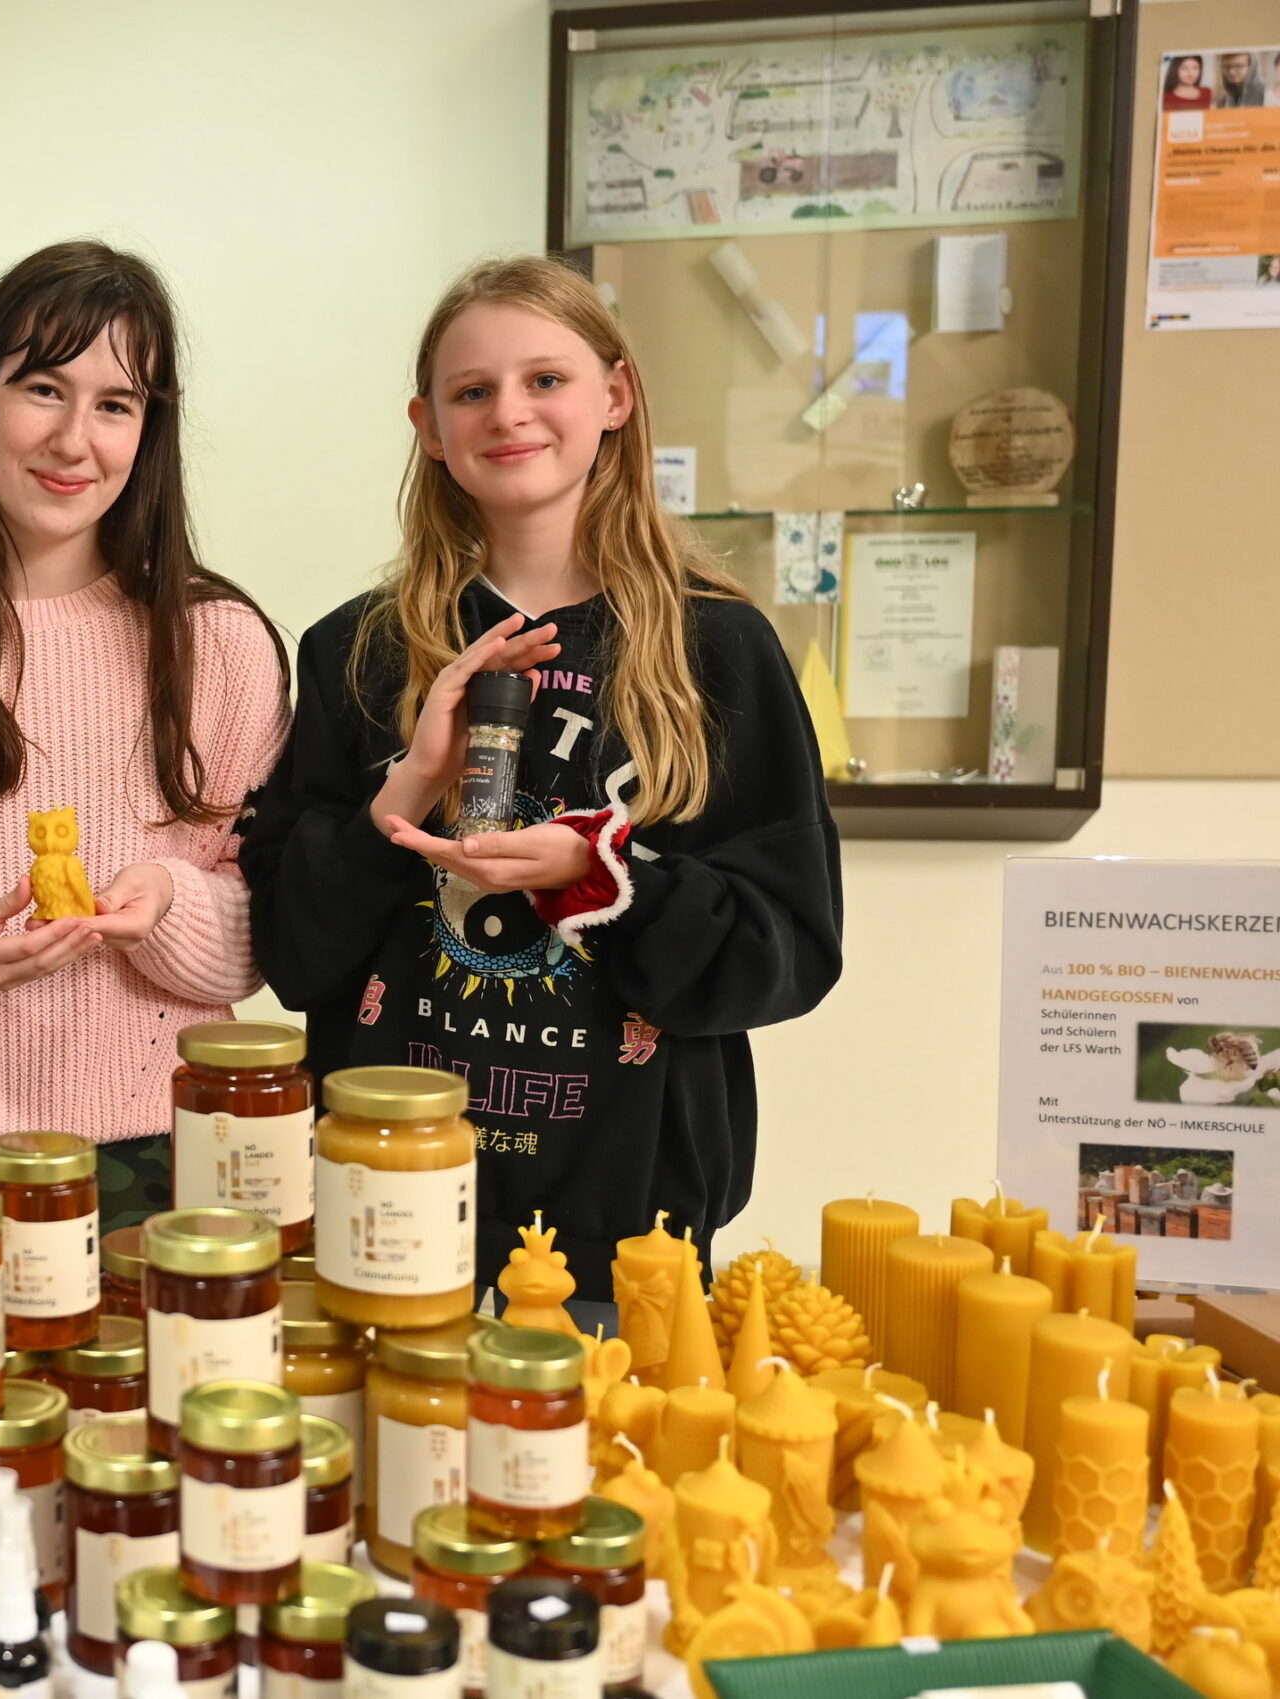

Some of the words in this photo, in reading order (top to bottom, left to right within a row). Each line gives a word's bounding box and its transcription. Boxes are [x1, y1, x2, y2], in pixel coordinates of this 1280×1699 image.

[1044, 910, 1280, 933] BIENENWACHSKERZE
[1042, 964, 1064, 976] Aus
[1067, 963, 1095, 976] 100
[1099, 964, 1113, 976] %
[1118, 964, 1146, 977] BIO
[1041, 988, 1174, 1004] HANDGEGOSSEN
[1177, 995, 1199, 1005] von
[1040, 1008, 1117, 1021] Schülerinnen
[1040, 1026, 1063, 1036] und
[1066, 1026, 1117, 1038] Schülern
[1040, 1043, 1060, 1053] der
[1063, 1043, 1082, 1054] LFS
[1085, 1044, 1122, 1055] Warth
[1039, 1096, 1059, 1107] Mit
[1038, 1113, 1122, 1129] Unterstützung
[1124, 1116, 1144, 1128] der
[1147, 1115, 1167, 1129] NÖ
[1180, 1121, 1266, 1134] IMKERSCHULE
